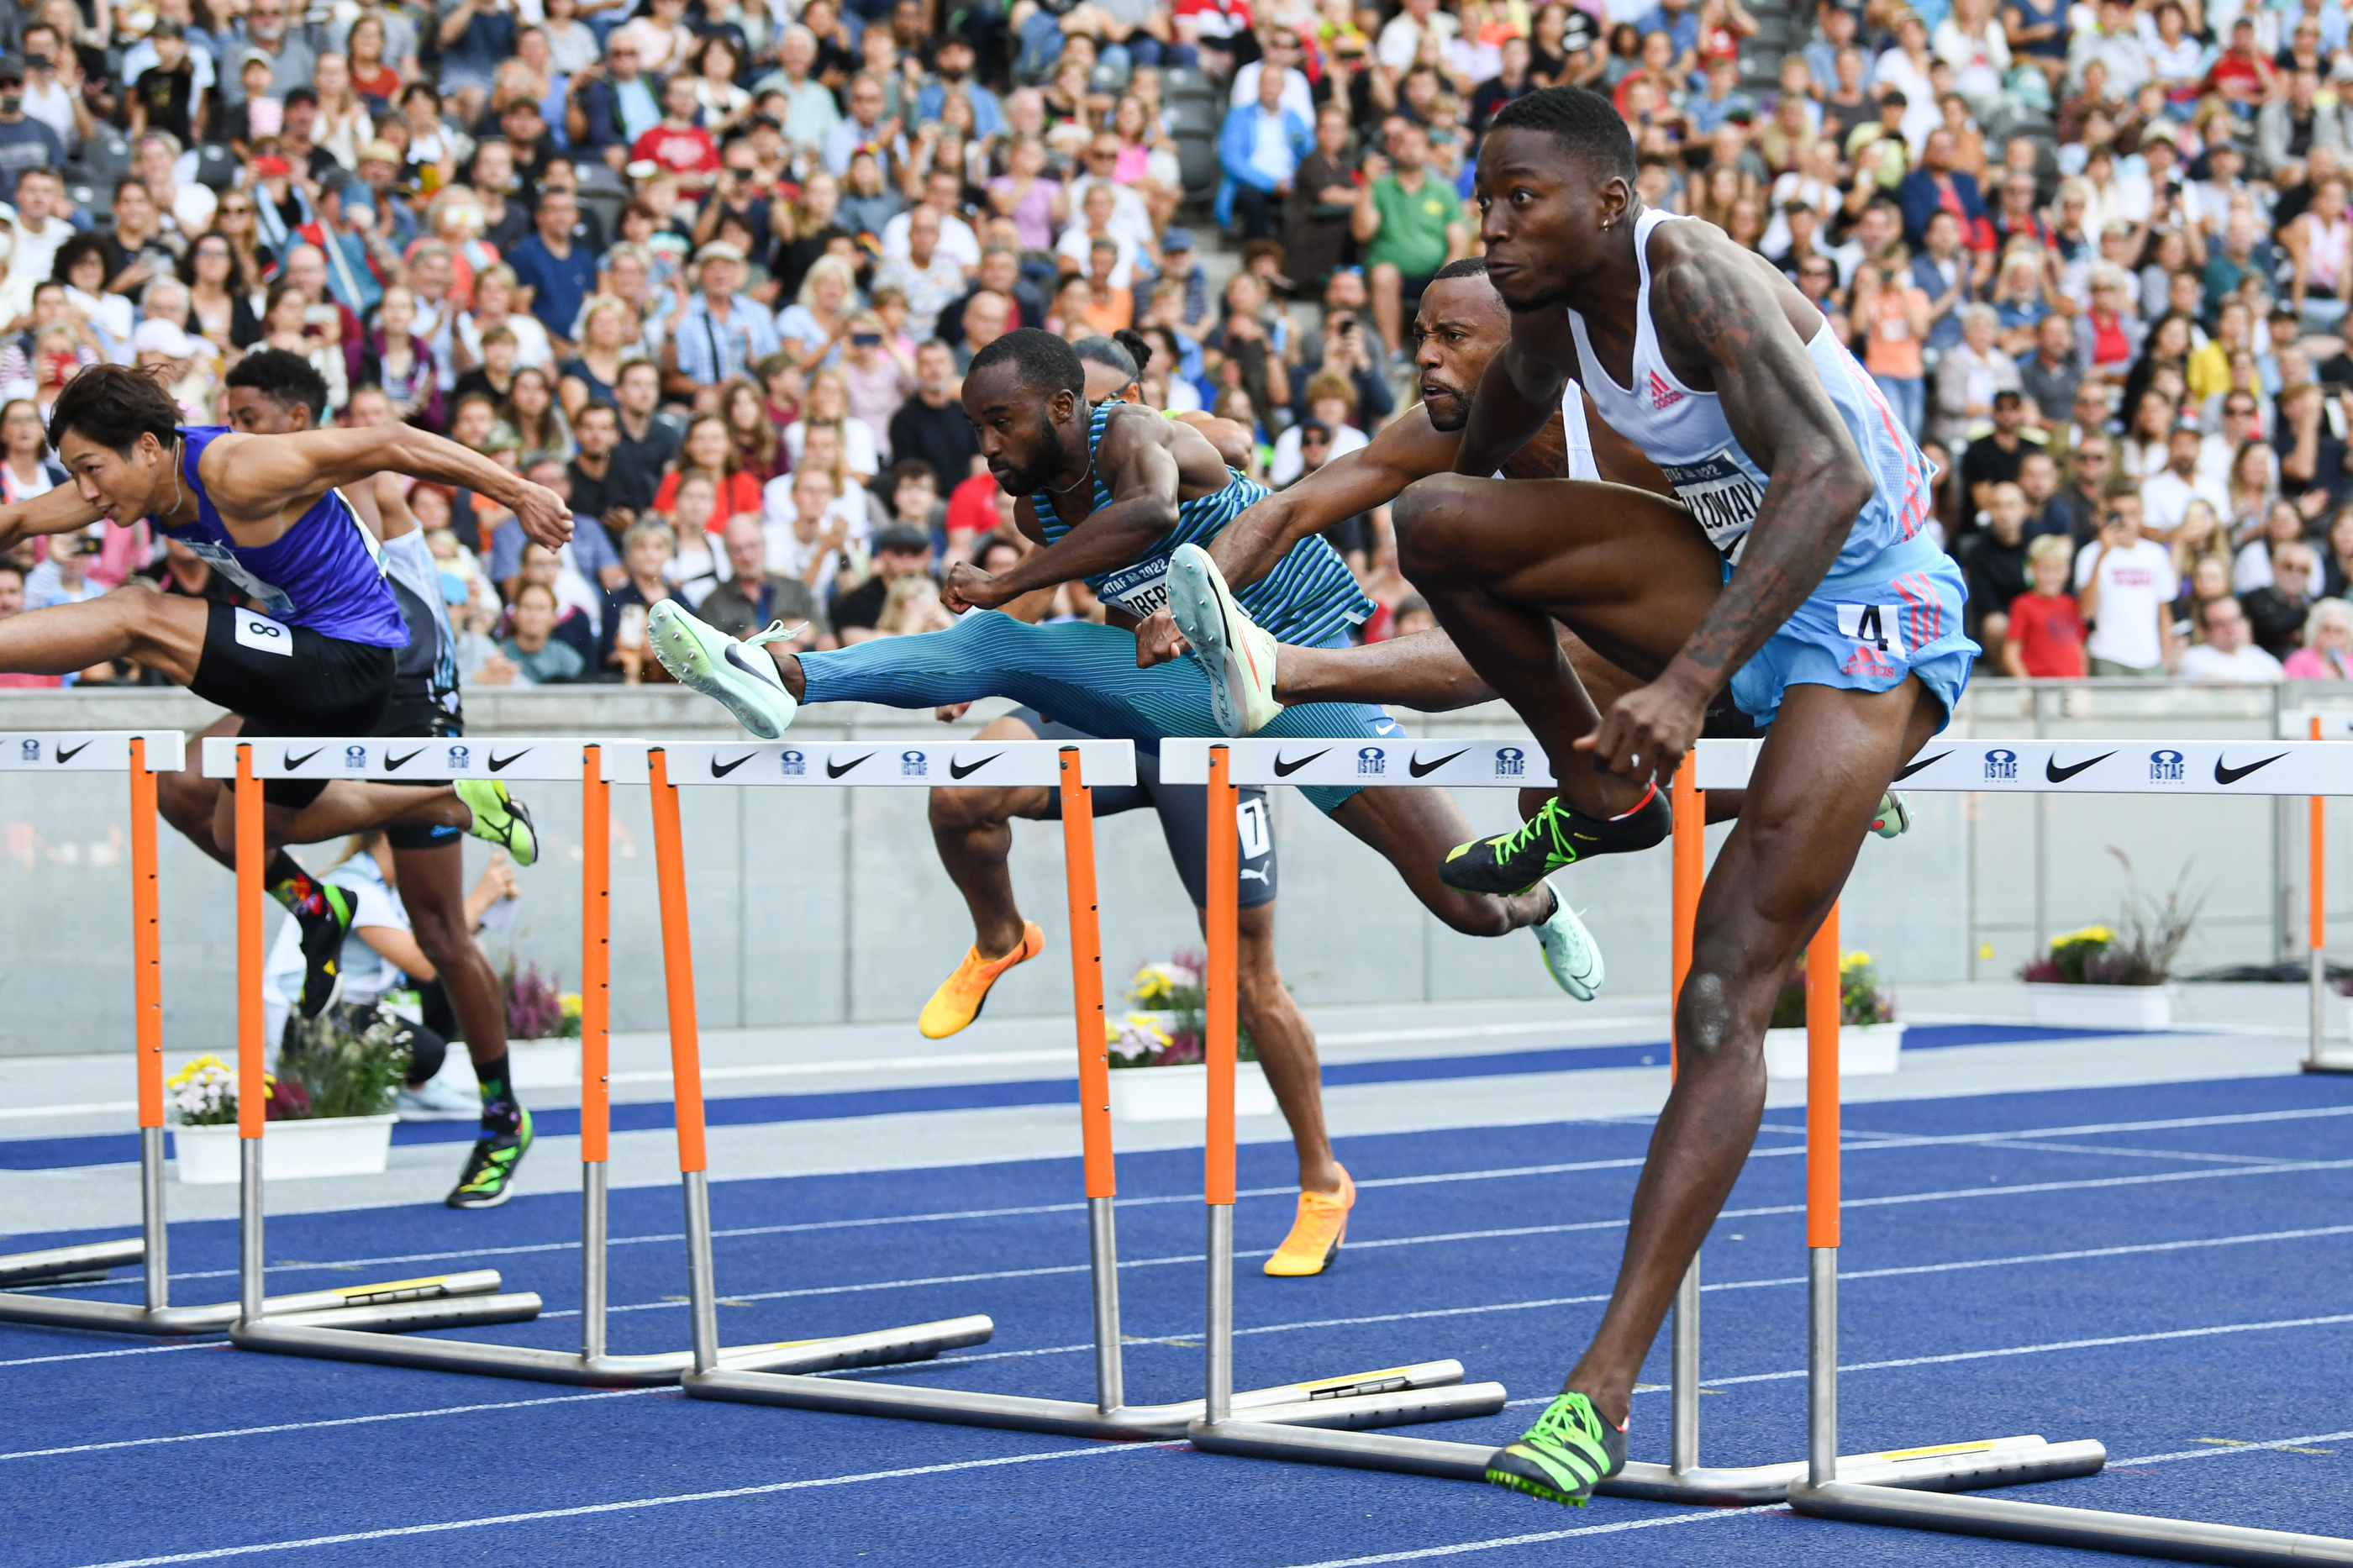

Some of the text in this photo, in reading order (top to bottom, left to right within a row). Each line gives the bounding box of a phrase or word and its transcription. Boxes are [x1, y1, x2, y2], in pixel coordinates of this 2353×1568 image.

[1138, 558, 1168, 578] 2022
[250, 622, 280, 637] 8
[1857, 604, 1888, 651] 4
[1840, 661, 1895, 678] adidas
[1984, 763, 2017, 778] ISTAF
[2150, 764, 2184, 779] ISTAF
[1245, 806, 1258, 845] 7
